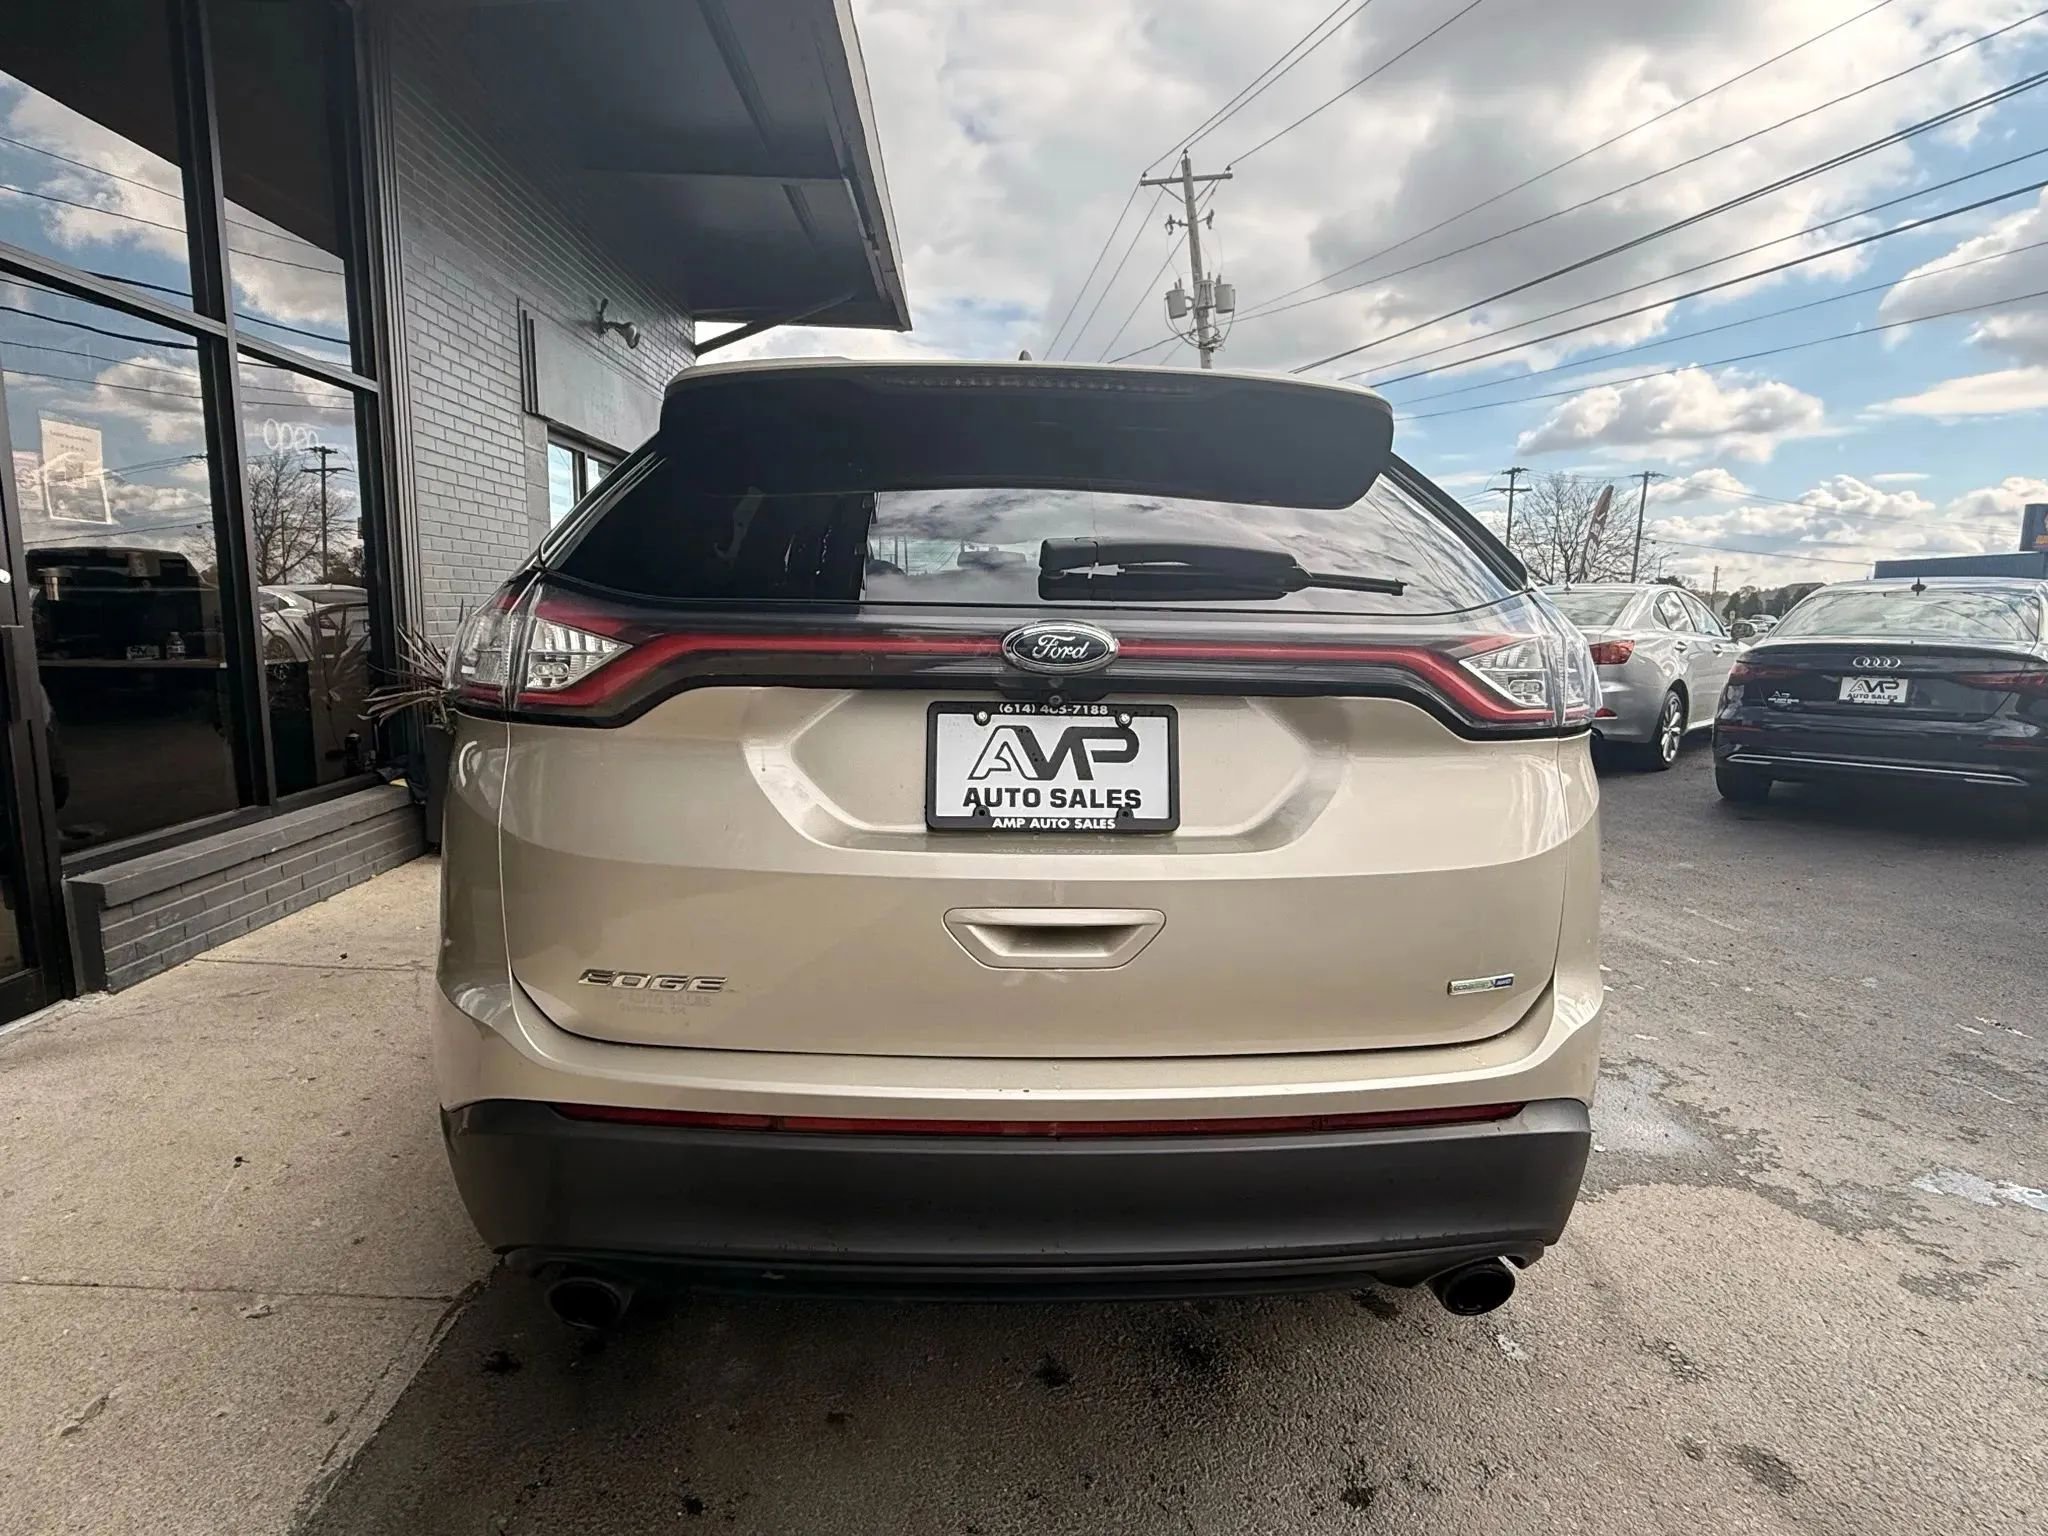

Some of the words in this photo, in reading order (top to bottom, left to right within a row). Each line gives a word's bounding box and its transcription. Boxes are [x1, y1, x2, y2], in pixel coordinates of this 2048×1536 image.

[263, 418, 319, 459] Open
[1032, 634, 1090, 659] Ford
[1000, 703, 1035, 714] (614)
[963, 787, 1041, 808] AUTO
[1050, 788, 1142, 809] SALES
[992, 818, 1025, 829] AMP
[1029, 818, 1070, 829] AUTO
[1074, 819, 1116, 830] SALES
[578, 969, 728, 993] EDGE
